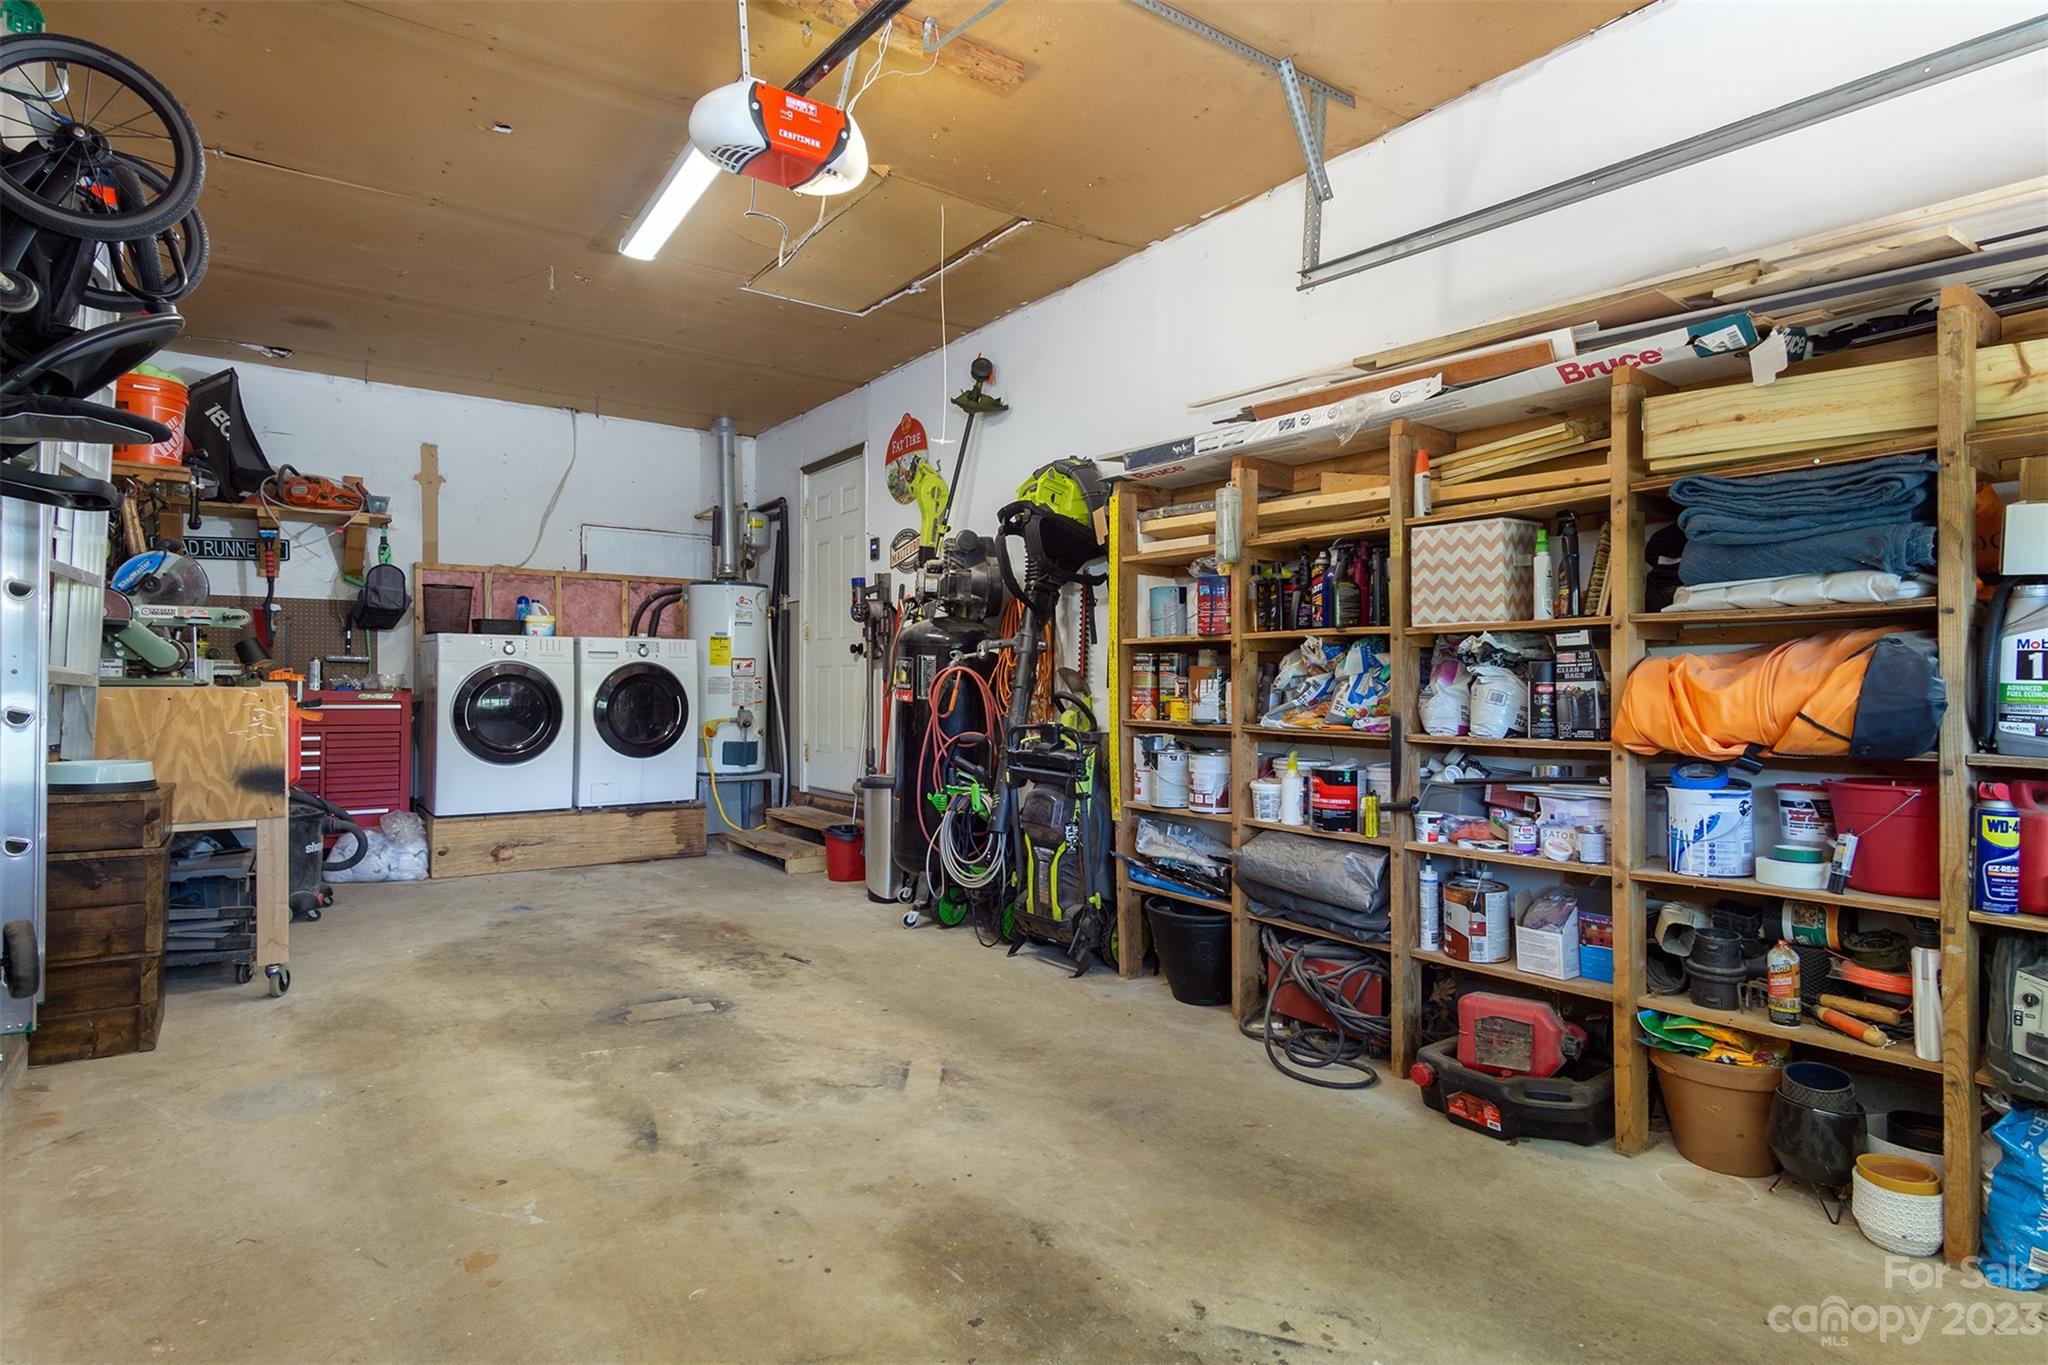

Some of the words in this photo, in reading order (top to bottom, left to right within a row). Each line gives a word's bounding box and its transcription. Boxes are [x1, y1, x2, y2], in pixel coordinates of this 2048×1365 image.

[779, 128, 821, 149] CRAFTSMAN
[1556, 349, 1663, 385] Bruce
[892, 440, 905, 454] FAT
[904, 433, 921, 448] TIRE
[1133, 465, 1186, 480] Bruce
[182, 540, 199, 556] AD
[2007, 684, 2043, 692] ADVANCED
